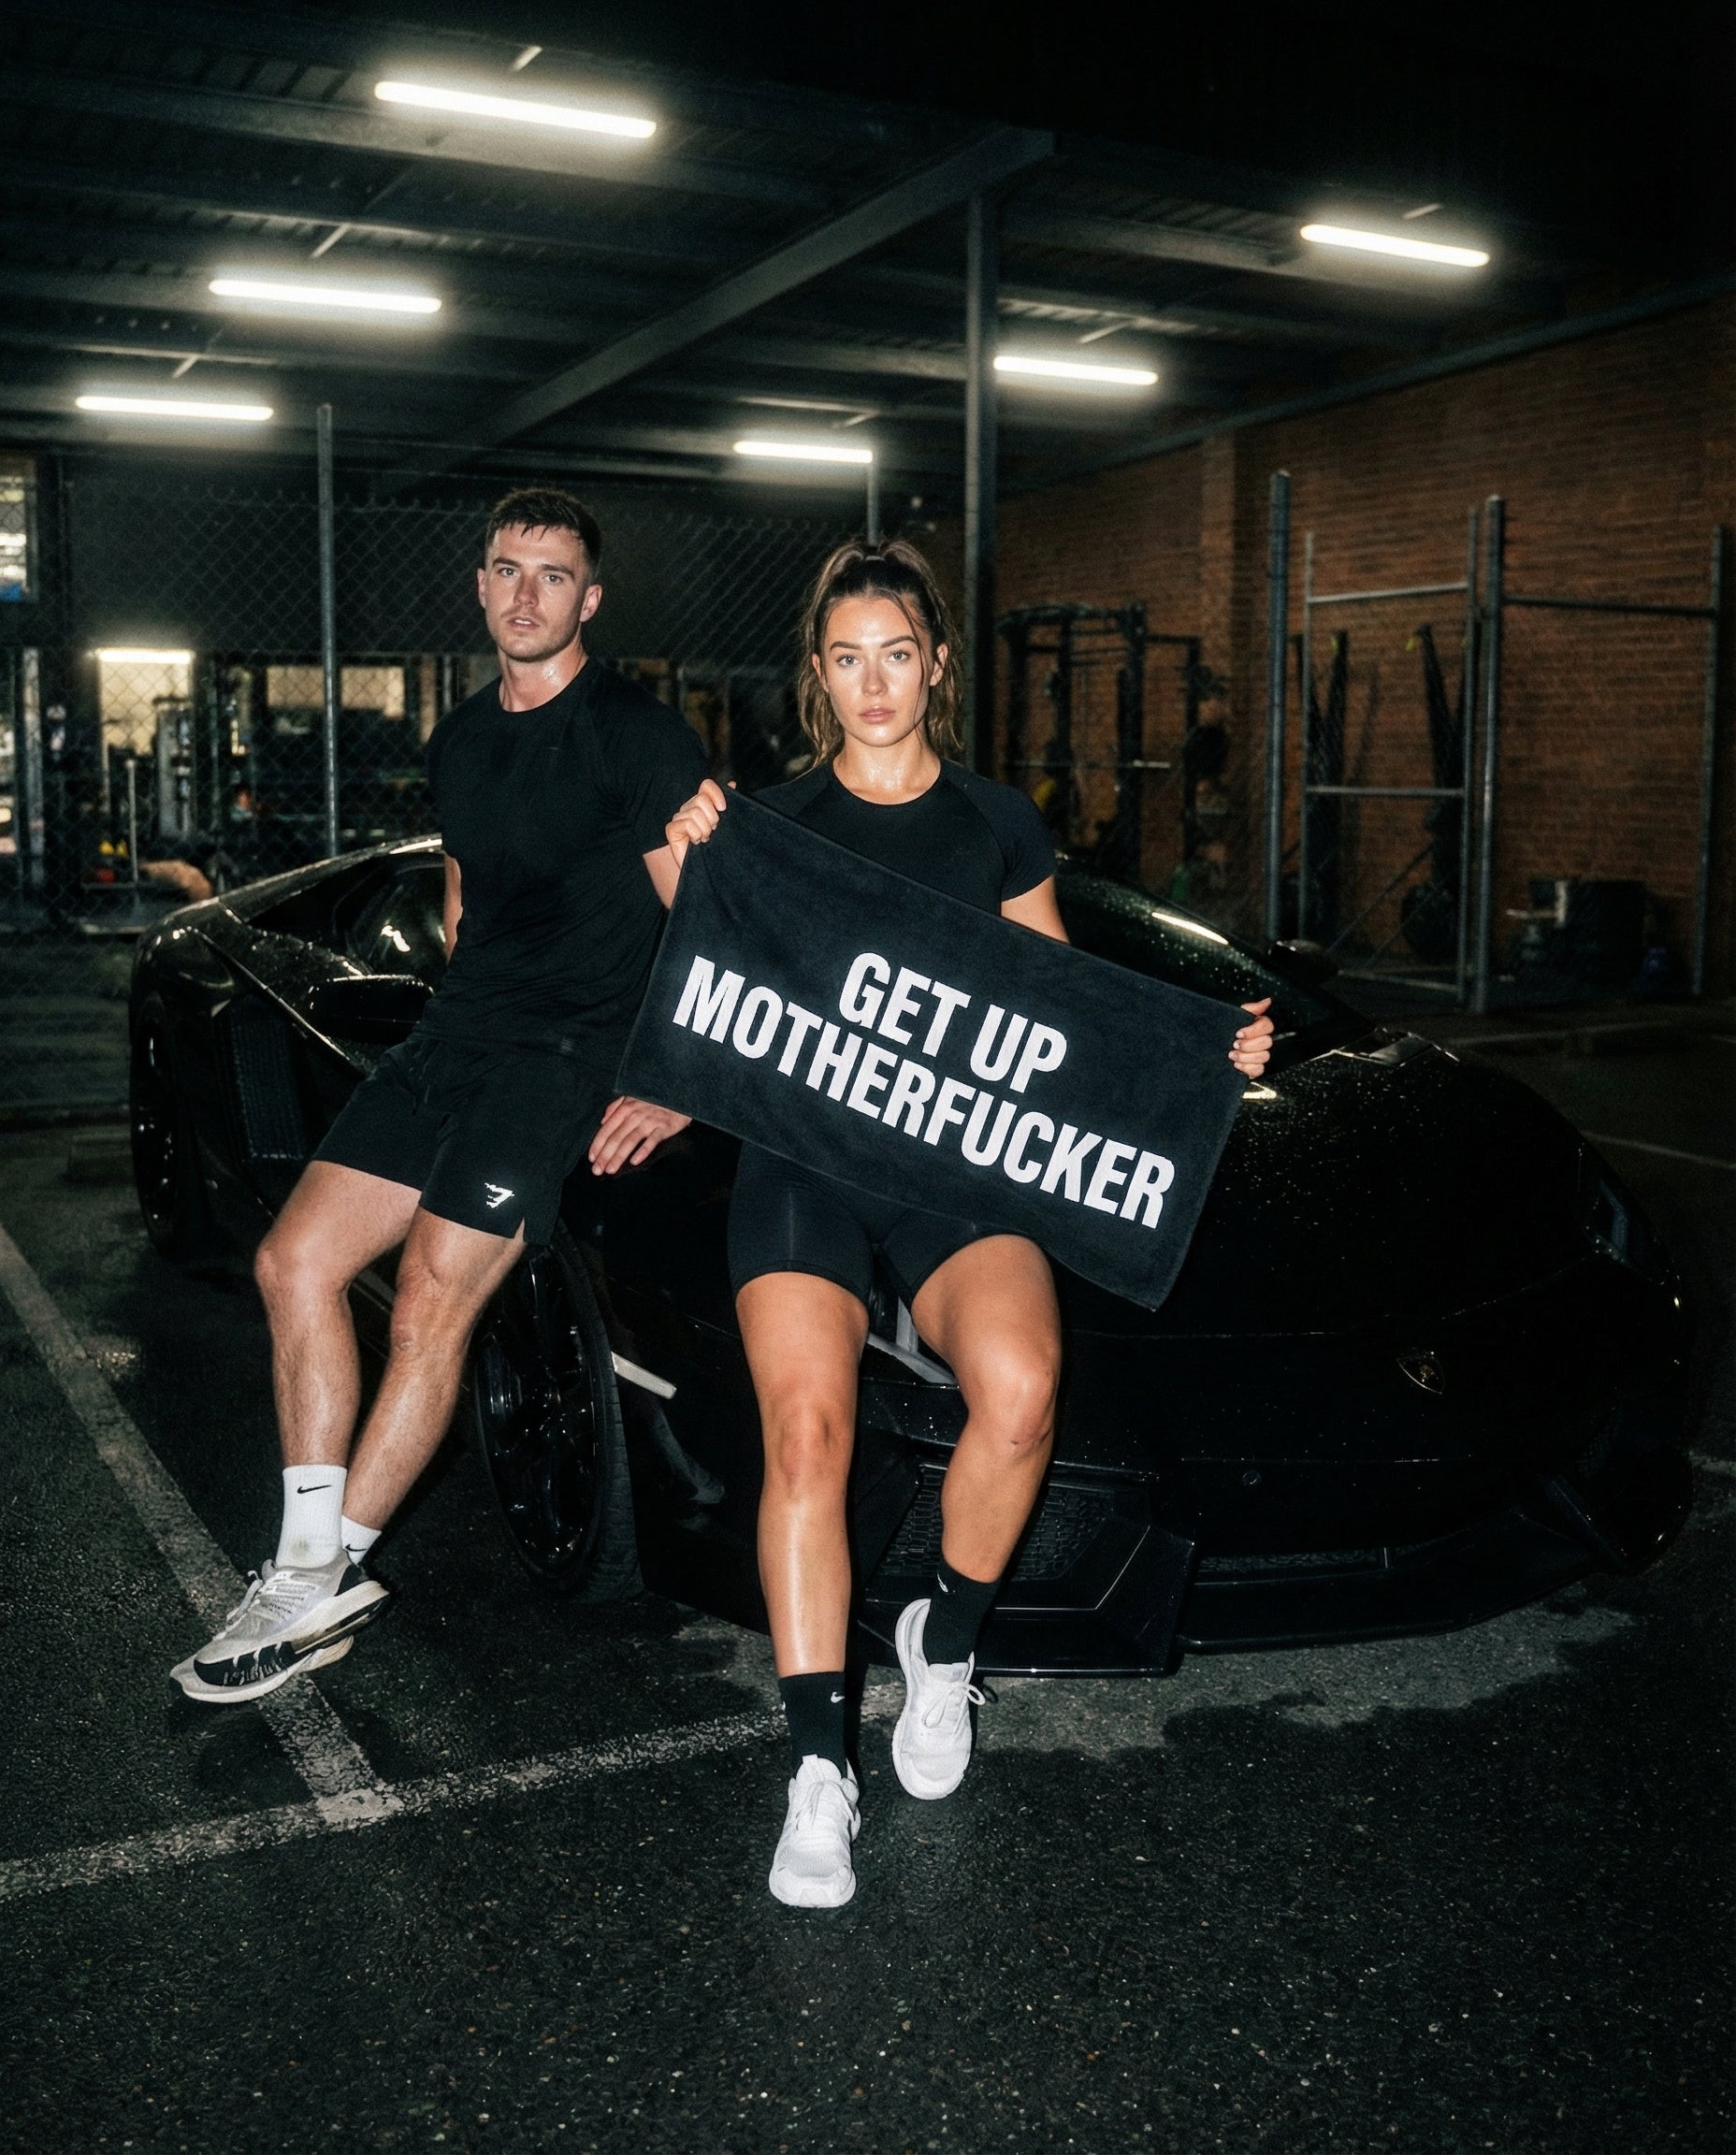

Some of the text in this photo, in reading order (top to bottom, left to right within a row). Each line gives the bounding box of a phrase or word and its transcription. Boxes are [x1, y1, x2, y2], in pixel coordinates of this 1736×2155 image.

[672, 954, 1176, 1229] MOTHERFUCKER
[838, 952, 1067, 1093] GET UP
